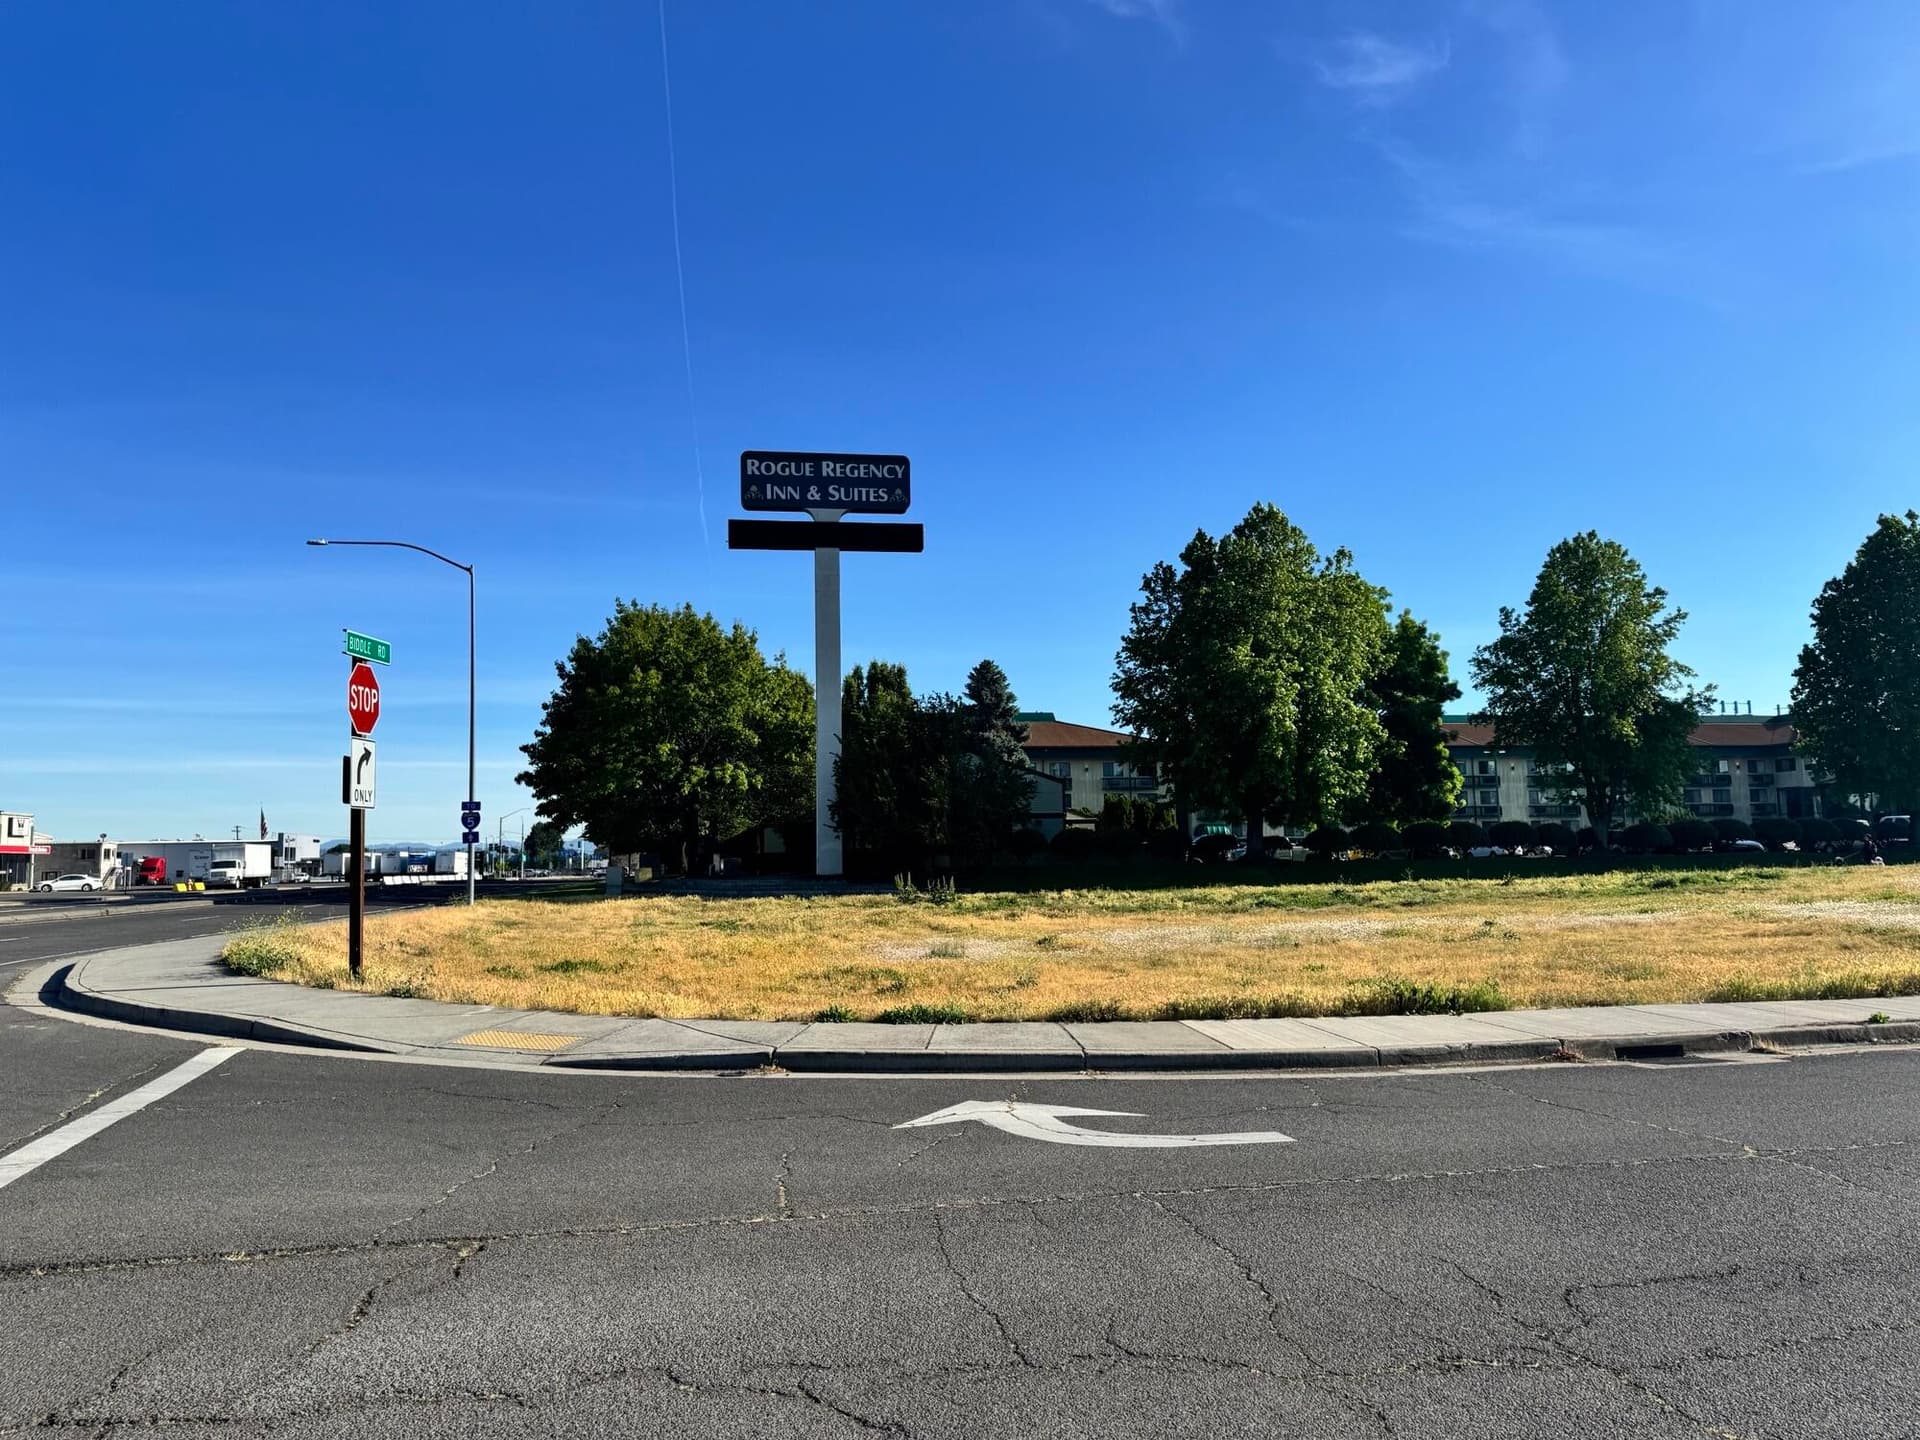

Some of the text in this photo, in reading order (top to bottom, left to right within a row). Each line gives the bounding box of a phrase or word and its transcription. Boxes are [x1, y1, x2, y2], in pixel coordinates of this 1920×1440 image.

[746, 458, 905, 479] ROGUE REGENCY
[766, 483, 889, 502] INN & SUITES
[349, 635, 386, 659] BIDDLE RD
[350, 684, 378, 713] STOP
[354, 788, 373, 803] ONLY
[467, 816, 475, 828] 5
